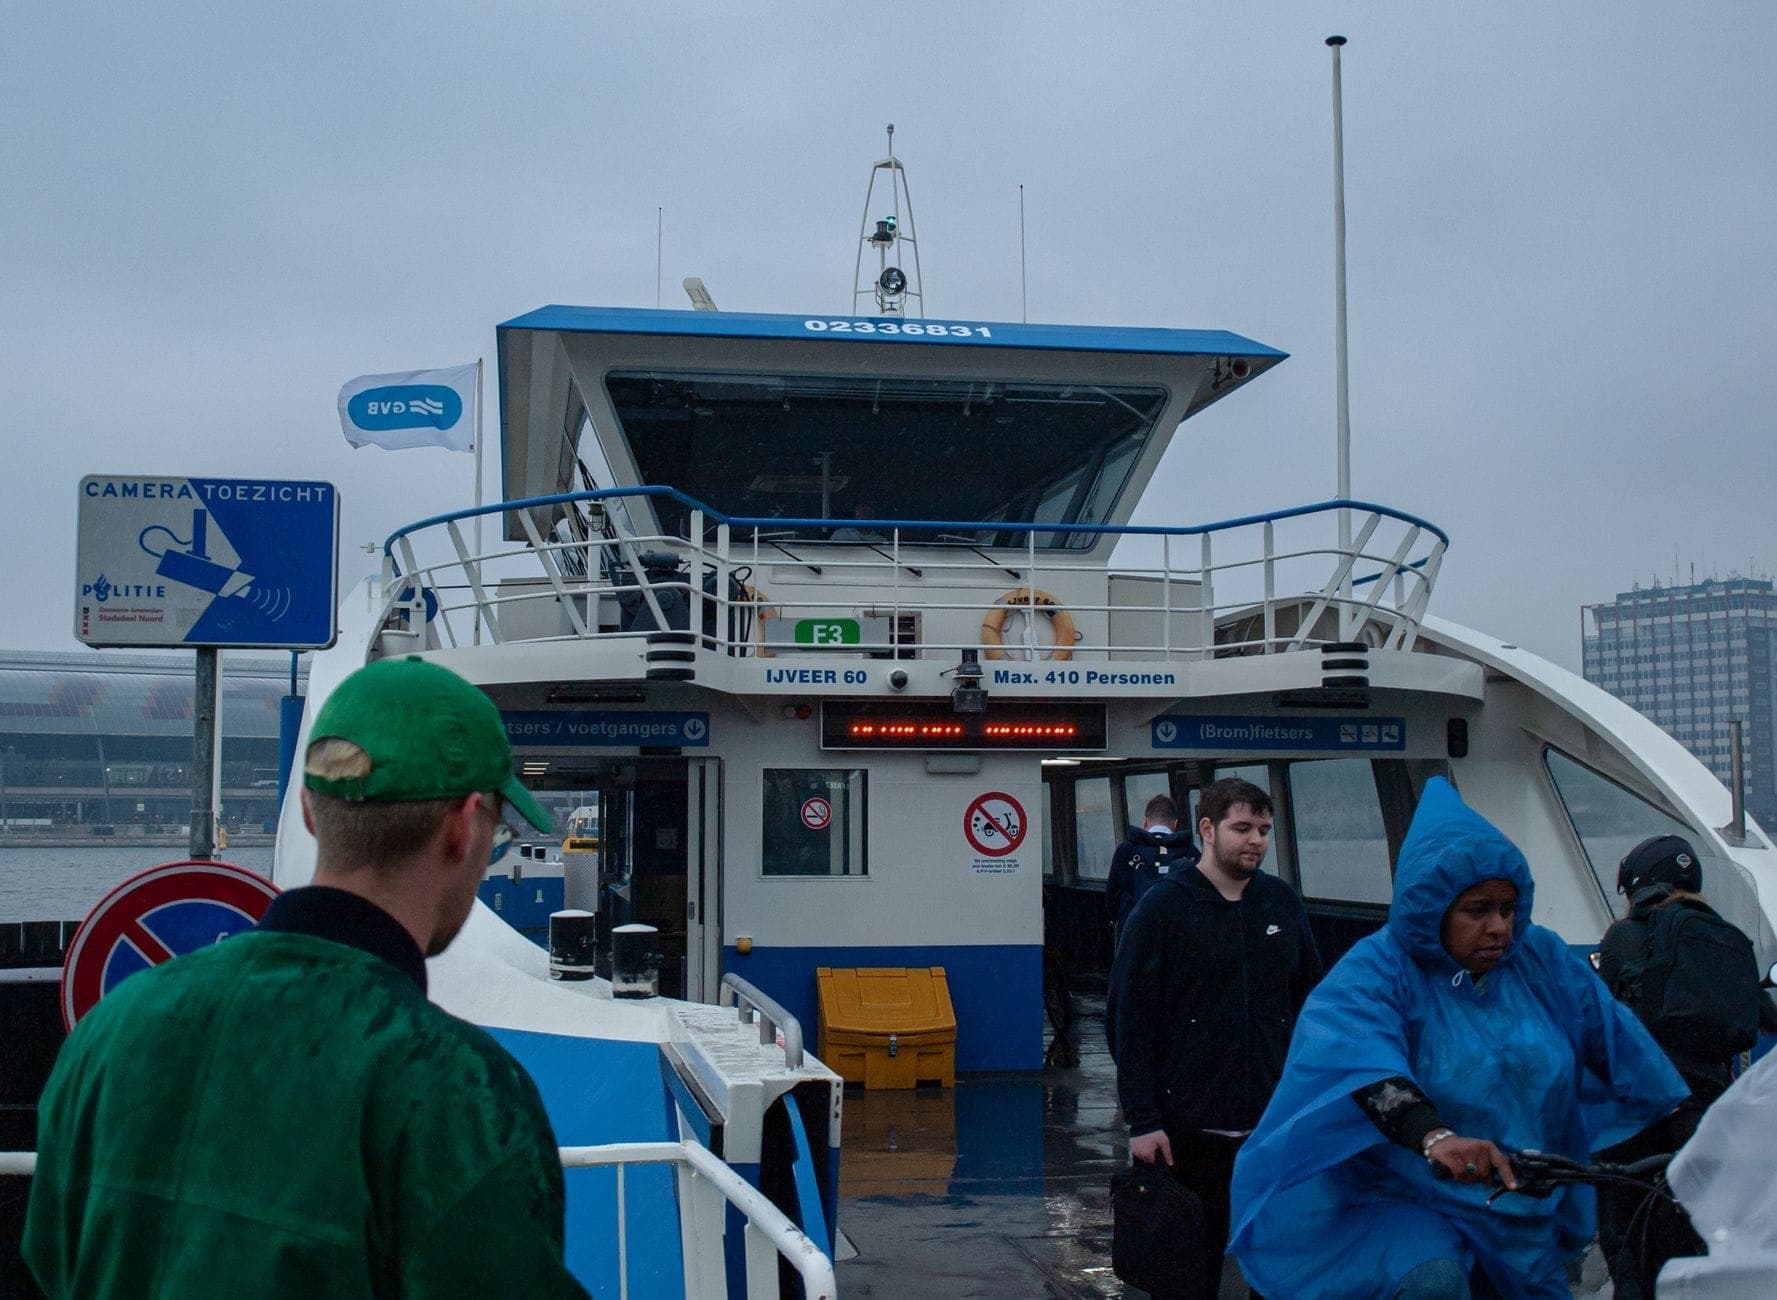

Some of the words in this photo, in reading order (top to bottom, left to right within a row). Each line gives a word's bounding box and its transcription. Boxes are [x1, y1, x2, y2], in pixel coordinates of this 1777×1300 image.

[804, 319, 992, 338] 02336831
[85, 482, 193, 499] CAMERA
[203, 484, 326, 502] TOEZICHT
[138, 614, 163, 622] Noord
[812, 624, 844, 645] F3
[766, 669, 837, 684] IJVEER
[843, 670, 867, 684] 60
[993, 670, 1038, 685] Max.
[1045, 670, 1080, 685] 410
[1086, 670, 1175, 685] Personen
[507, 721, 550, 735] tsers
[568, 721, 677, 738] voetgangers
[1200, 723, 1313, 740] (Brom)fietsers
